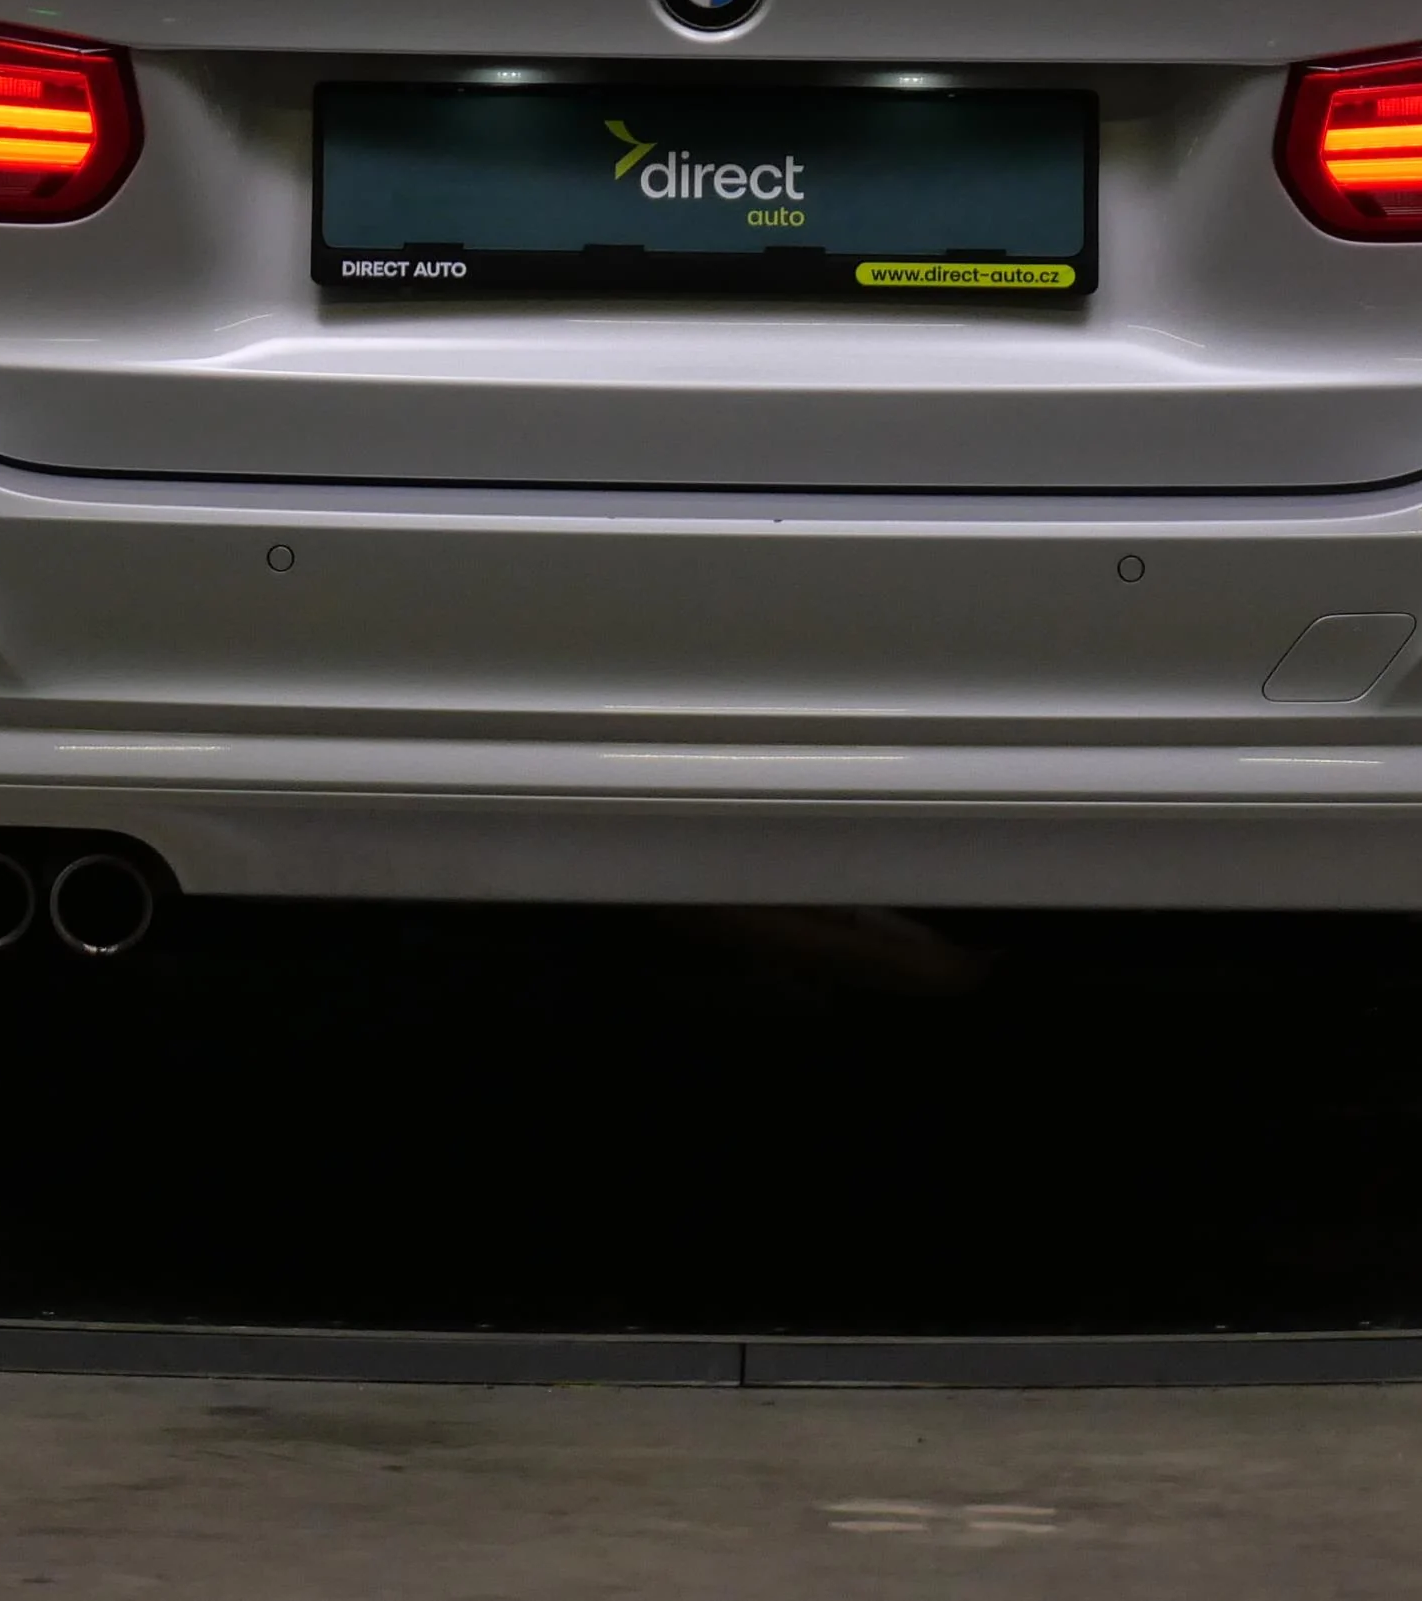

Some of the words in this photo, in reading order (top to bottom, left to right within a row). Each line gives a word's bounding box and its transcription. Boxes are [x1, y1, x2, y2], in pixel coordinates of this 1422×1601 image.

[640, 150, 806, 200] direct
[747, 206, 806, 227] auto
[341, 260, 410, 277] DIRECT
[413, 261, 467, 278] AUTO
[870, 265, 1060, 284] www.direct-auto.cz
